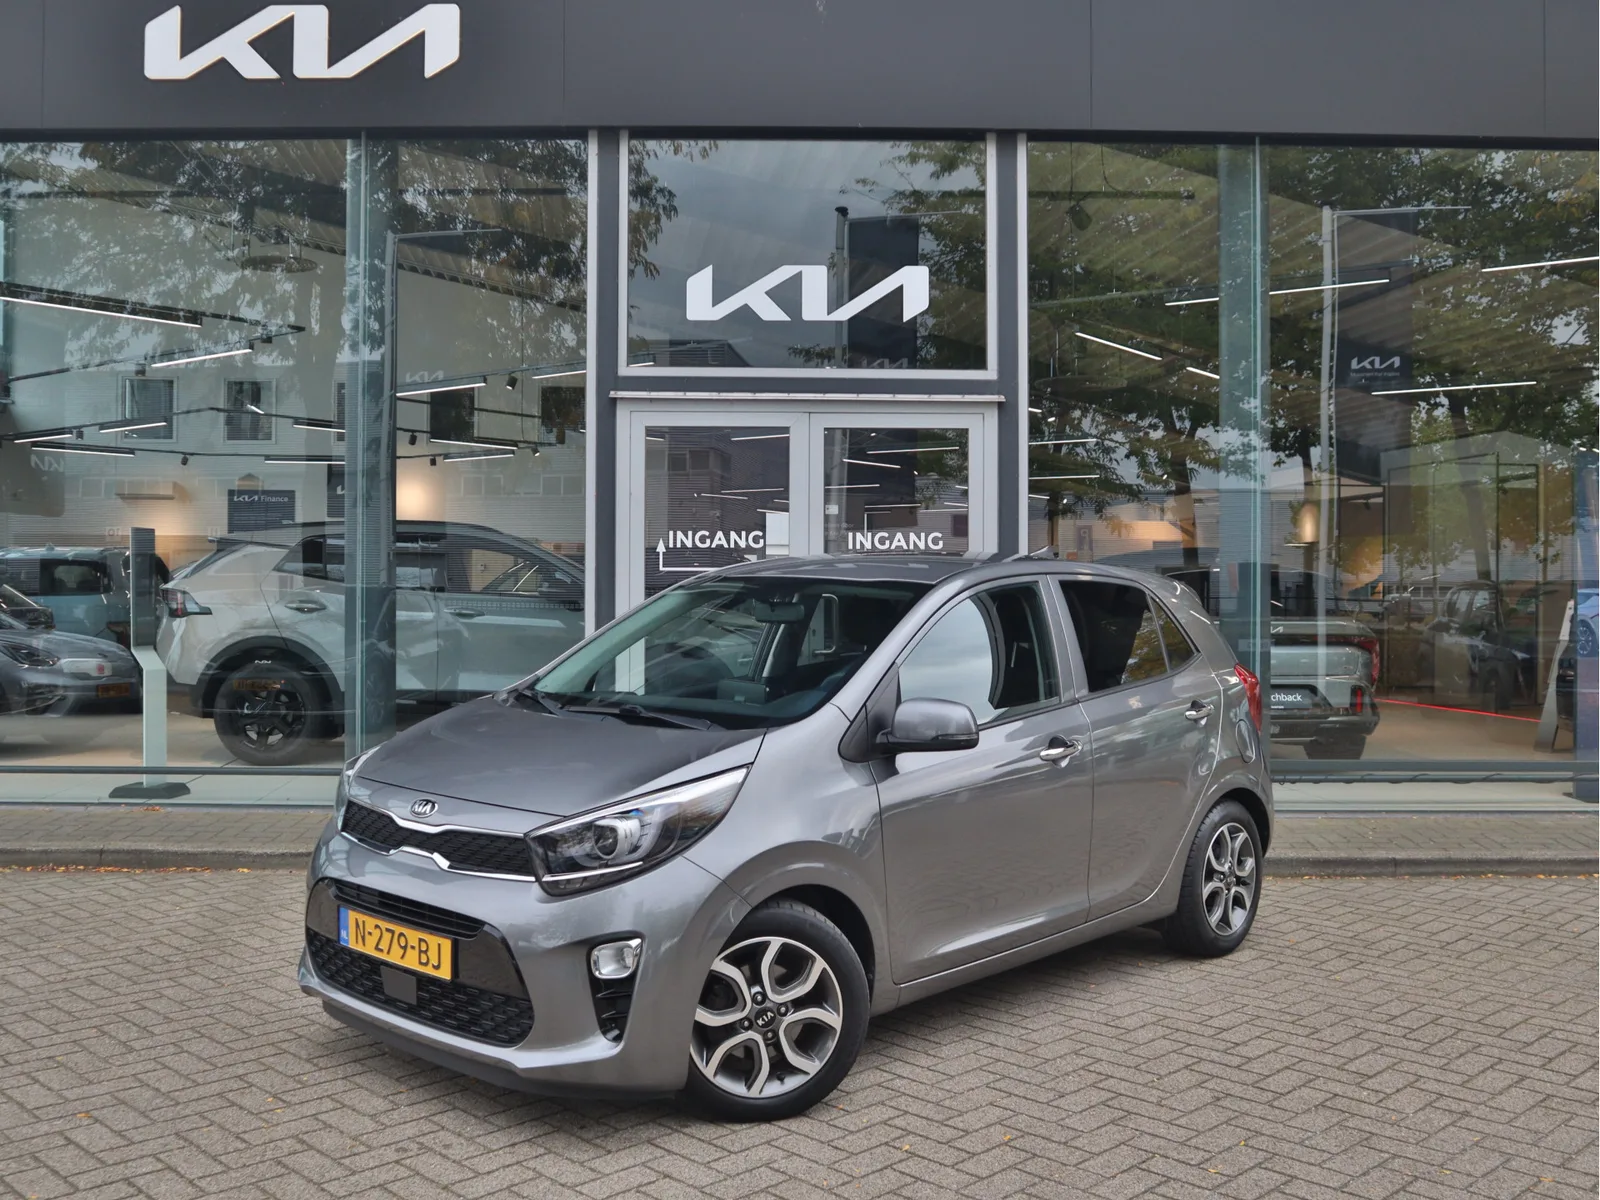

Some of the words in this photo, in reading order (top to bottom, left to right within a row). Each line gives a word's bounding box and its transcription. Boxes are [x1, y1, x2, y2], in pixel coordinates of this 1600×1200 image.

[144, 3, 460, 80] KIA
[686, 264, 930, 323] KIA
[1351, 356, 1400, 369] KIA
[668, 530, 765, 549] INGANG
[847, 531, 944, 550] INGANG
[1270, 692, 1303, 702] chback
[412, 800, 433, 814] KIA
[354, 917, 442, 971] N-279-BJ
[756, 1011, 775, 1027] KIA
